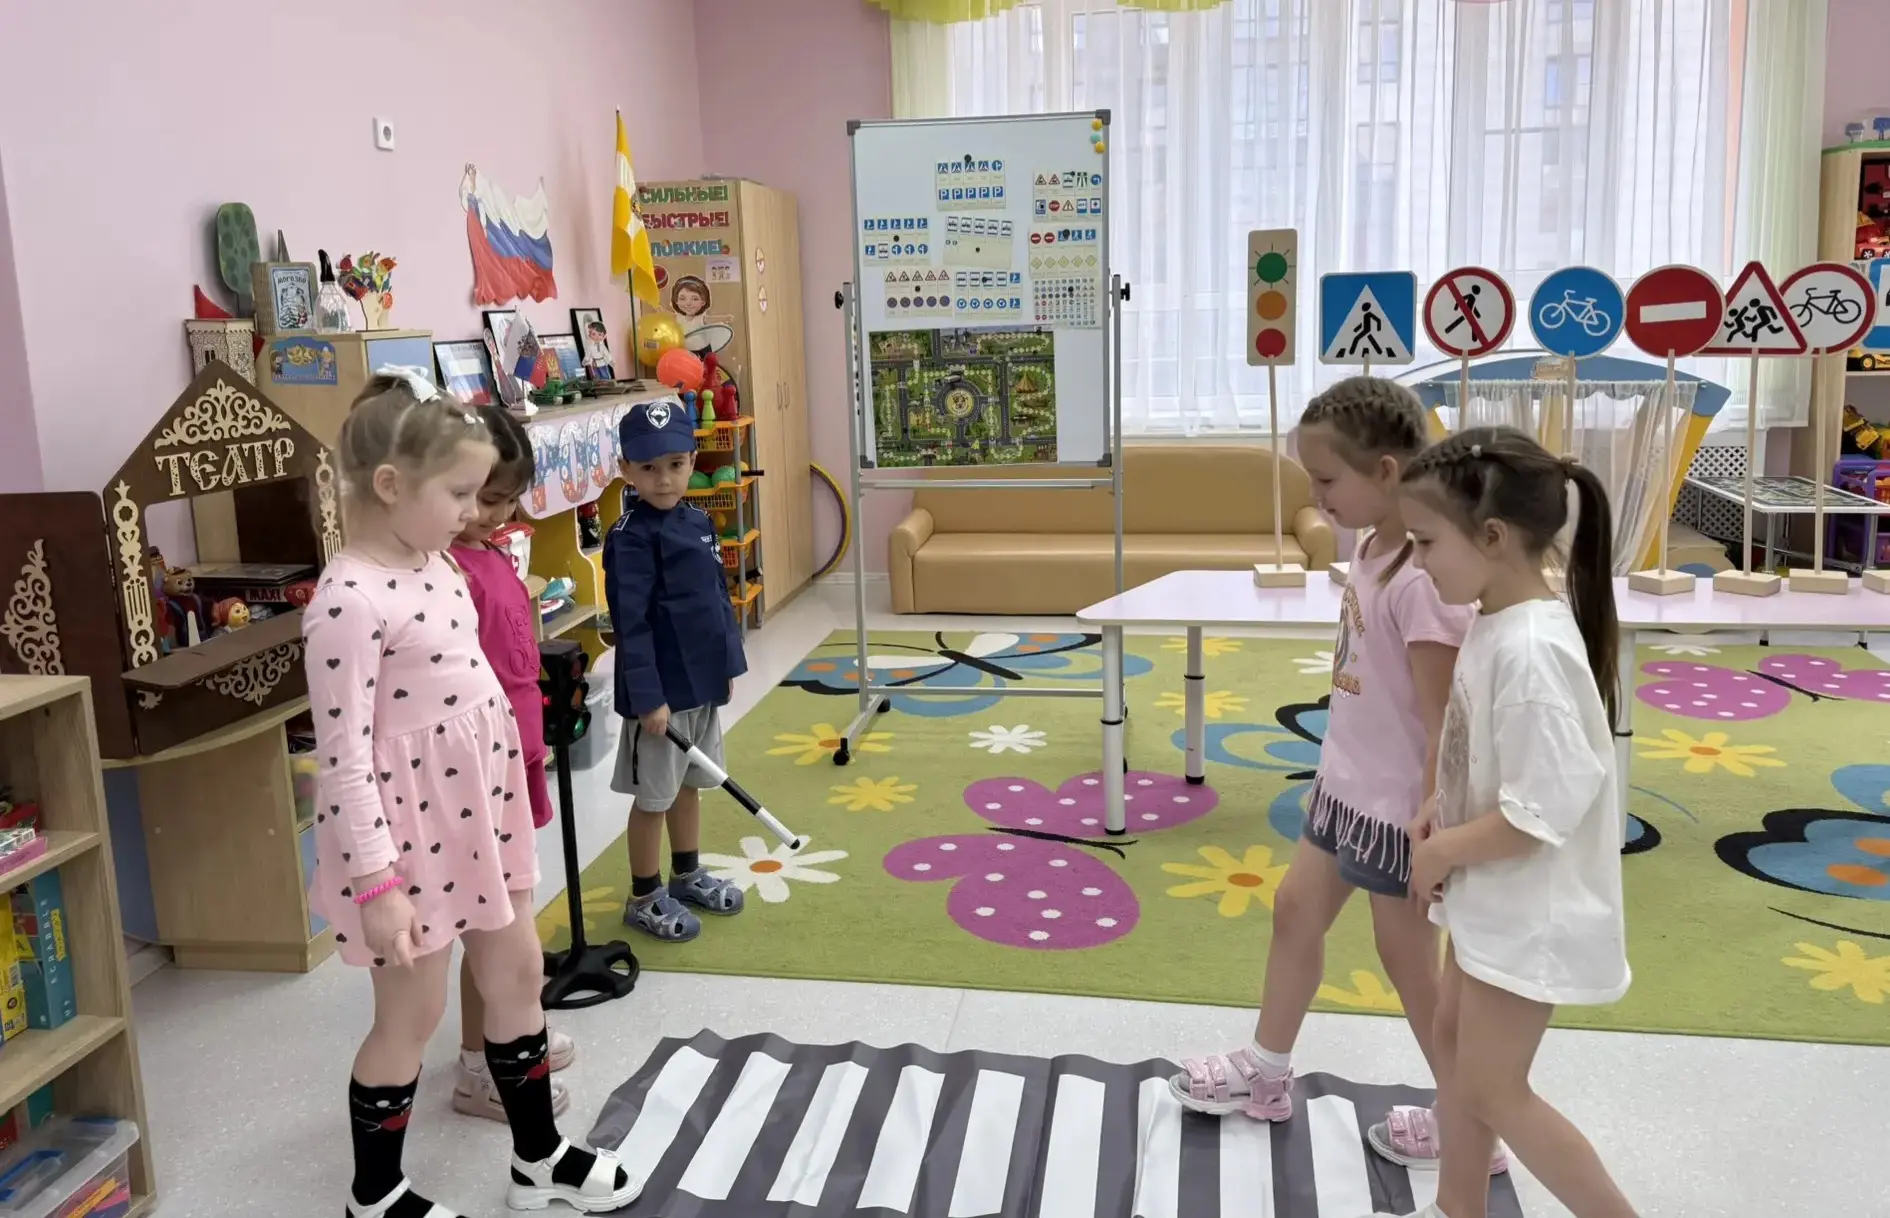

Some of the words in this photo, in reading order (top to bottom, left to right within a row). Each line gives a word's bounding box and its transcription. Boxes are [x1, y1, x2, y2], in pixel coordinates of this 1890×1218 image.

[639, 185, 729, 203] СИЛЬНЫЕ!
[641, 211, 730, 229] БЫСТРЫЕ!
[651, 239, 722, 256] ЛОВКИЕ!
[155, 437, 295, 496] ТЕАТР
